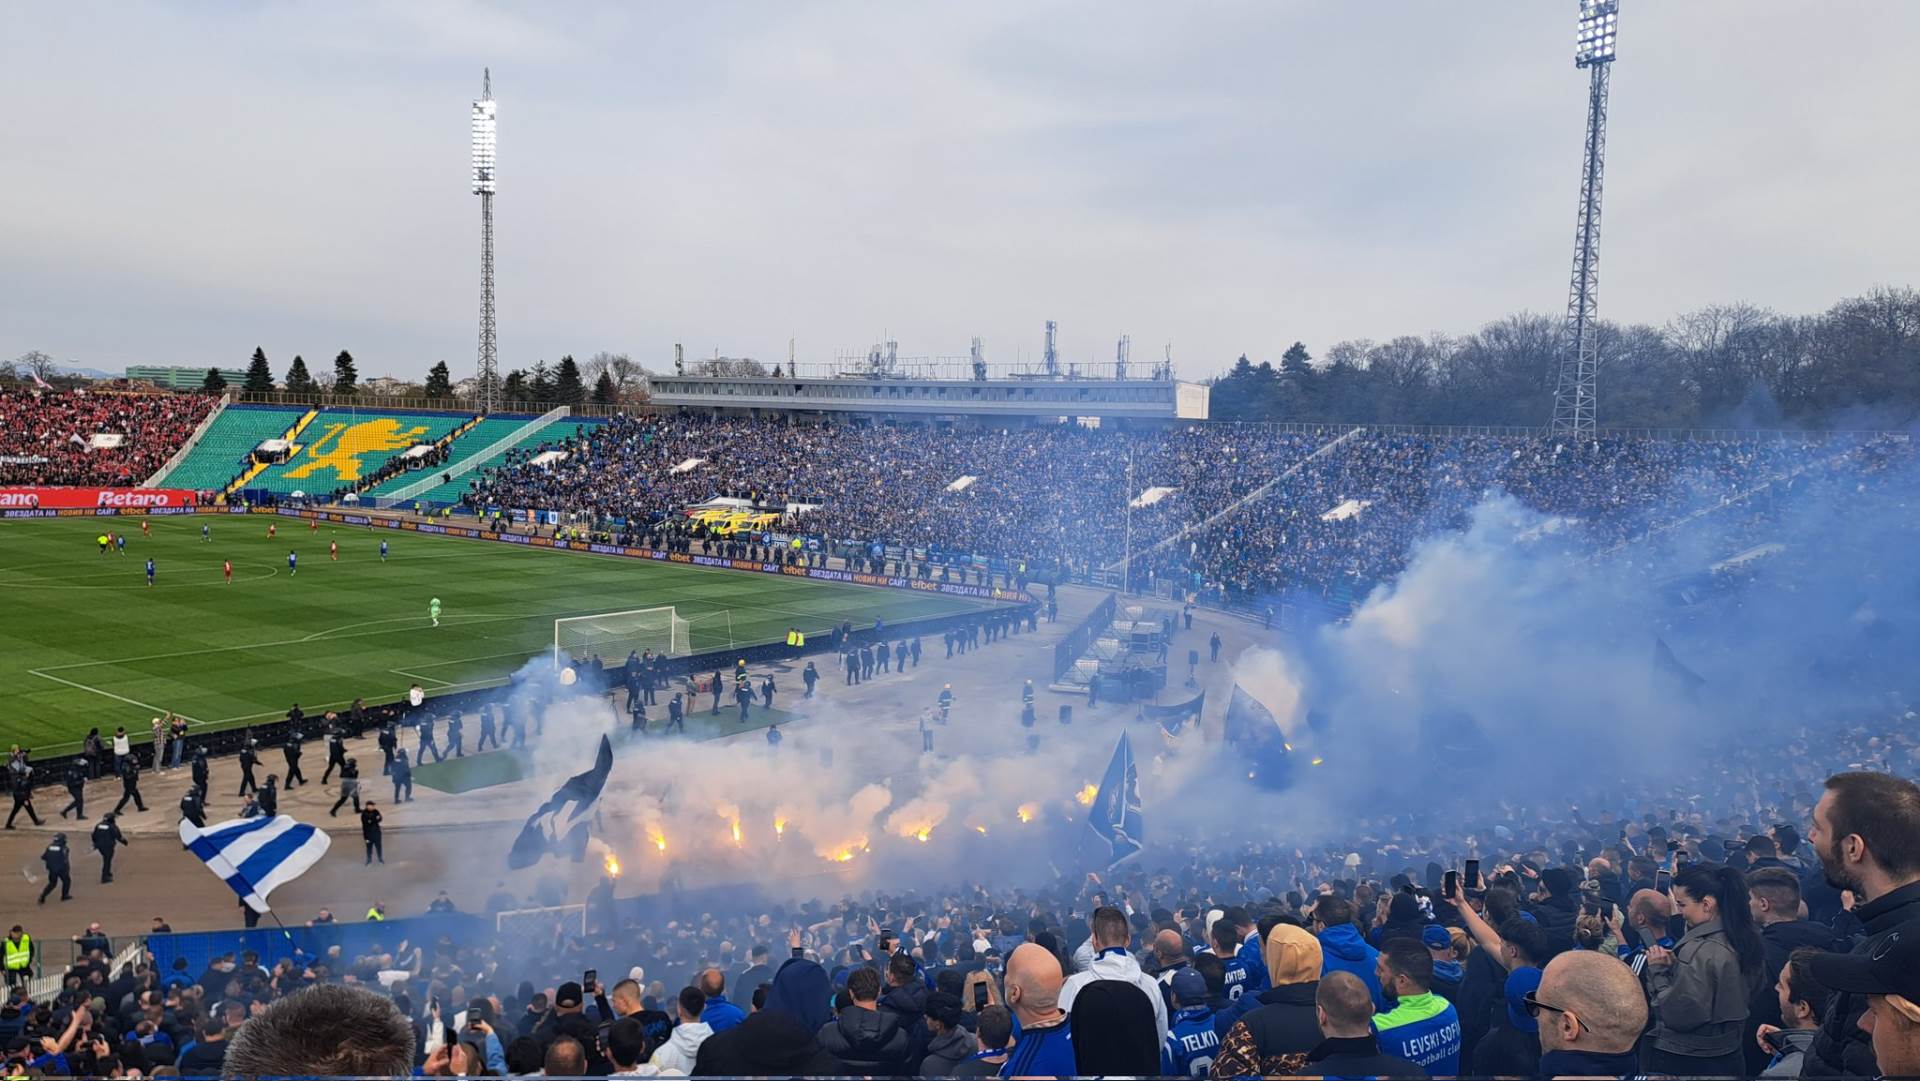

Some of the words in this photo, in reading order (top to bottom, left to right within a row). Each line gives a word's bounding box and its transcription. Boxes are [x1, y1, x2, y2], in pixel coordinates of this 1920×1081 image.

[0, 493, 38, 505] ano
[97, 491, 168, 506] Betano
[809, 568, 842, 580] ЗВЕЗДАТА
[853, 574, 876, 584] НОВИЯ
[888, 576, 907, 587] САЙТ
[911, 580, 937, 591] efbet
[1402, 1031, 1440, 1057] LEVSKI
[1411, 1048, 1446, 1067] otball
